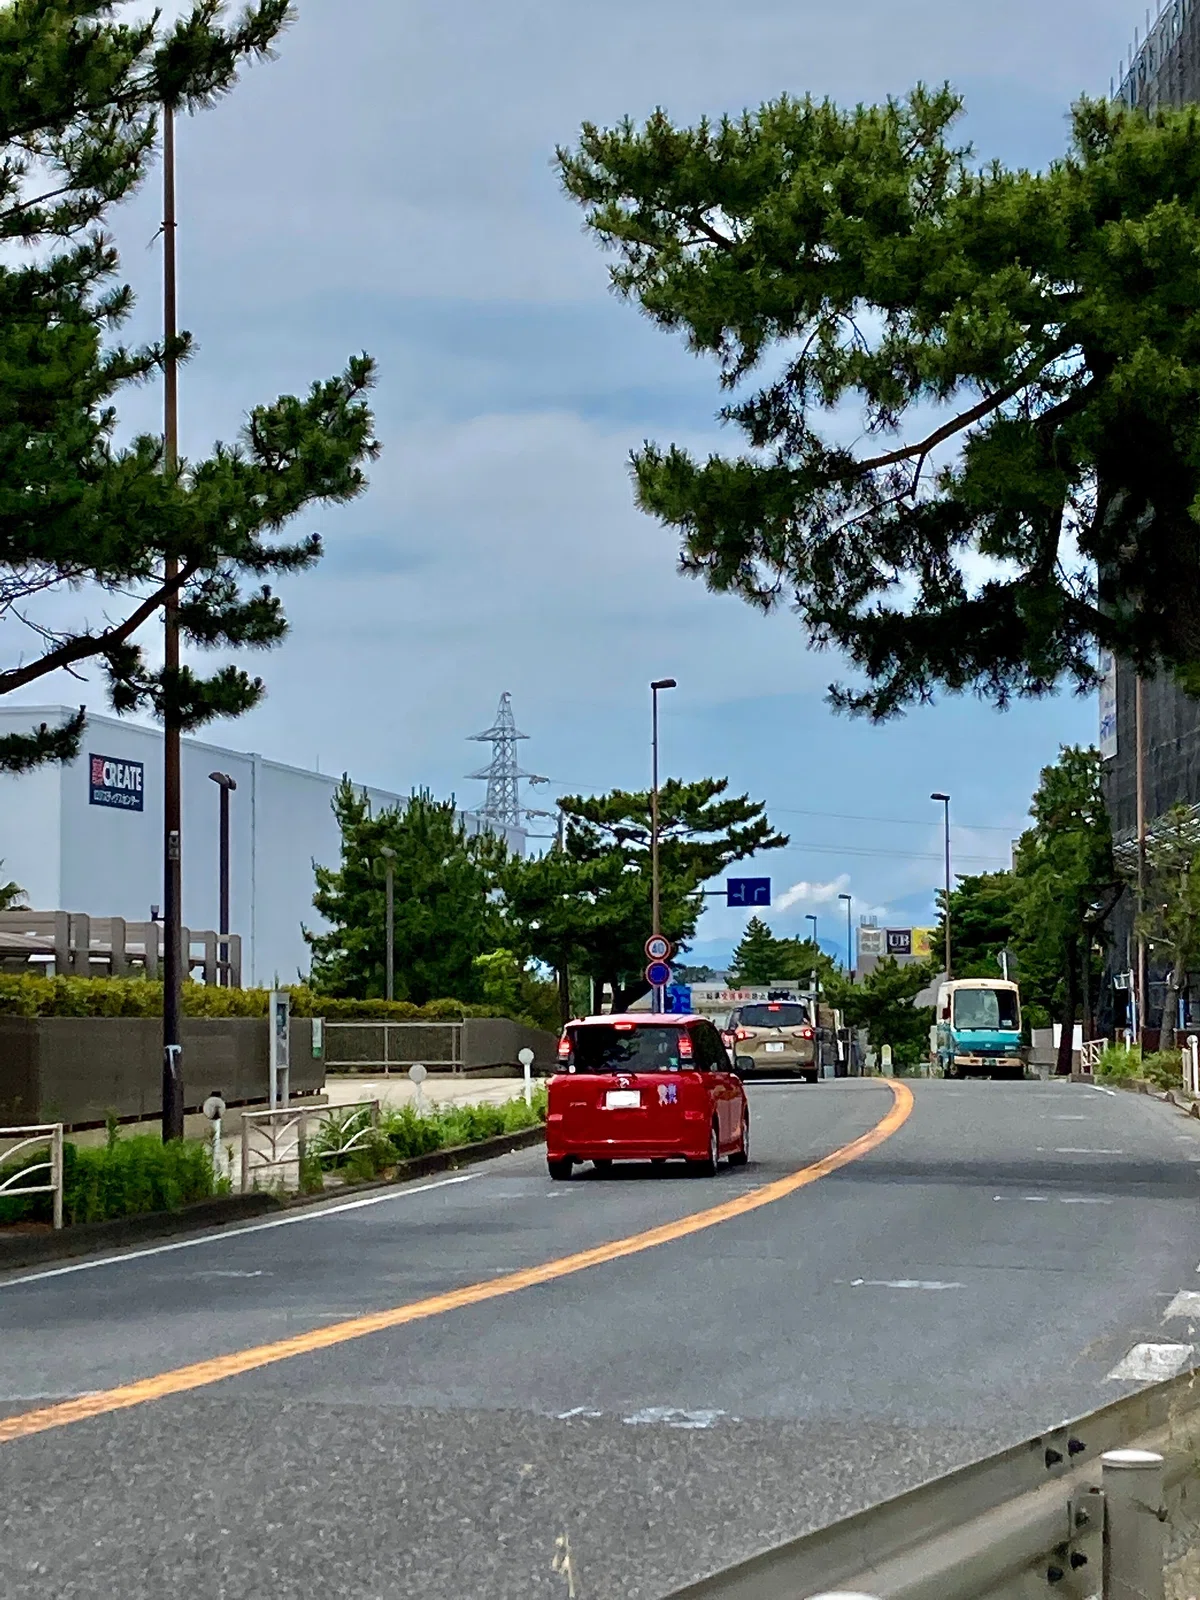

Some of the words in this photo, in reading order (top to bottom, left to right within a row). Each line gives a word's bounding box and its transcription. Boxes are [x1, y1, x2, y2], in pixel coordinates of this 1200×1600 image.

[103, 761, 142, 791] CREATE
[888, 933, 910, 947] UB
[651, 942, 665, 954] 40
